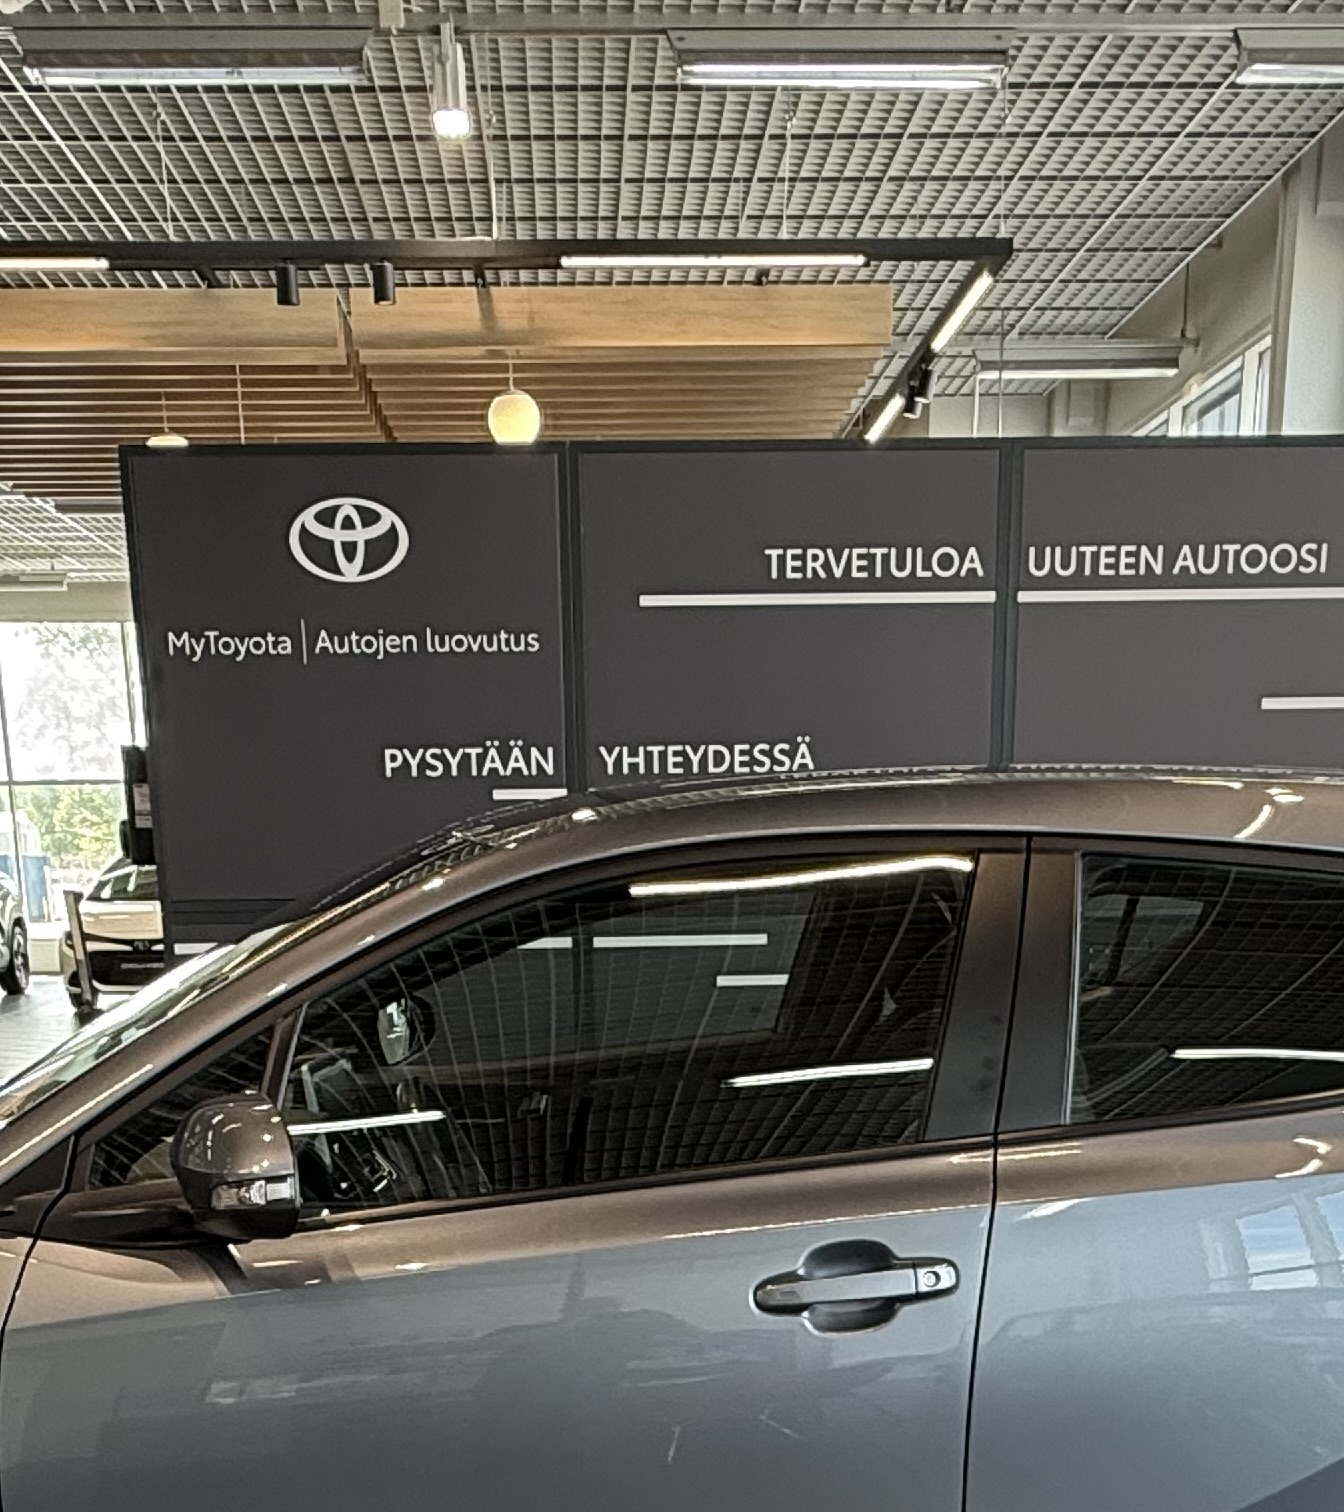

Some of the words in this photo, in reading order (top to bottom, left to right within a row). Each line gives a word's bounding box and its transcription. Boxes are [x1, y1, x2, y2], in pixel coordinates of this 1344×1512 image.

[764, 546, 984, 580] TERVETULOA
[1028, 544, 1165, 577] UUTEEN
[1171, 542, 1329, 576] AUTOOSI
[167, 630, 292, 662] MyToyota
[314, 628, 418, 660] Autojen
[426, 626, 540, 654] luovutus
[384, 739, 555, 778] PYSYTÄÄN
[599, 735, 815, 775] YHTEYDESSÄ
